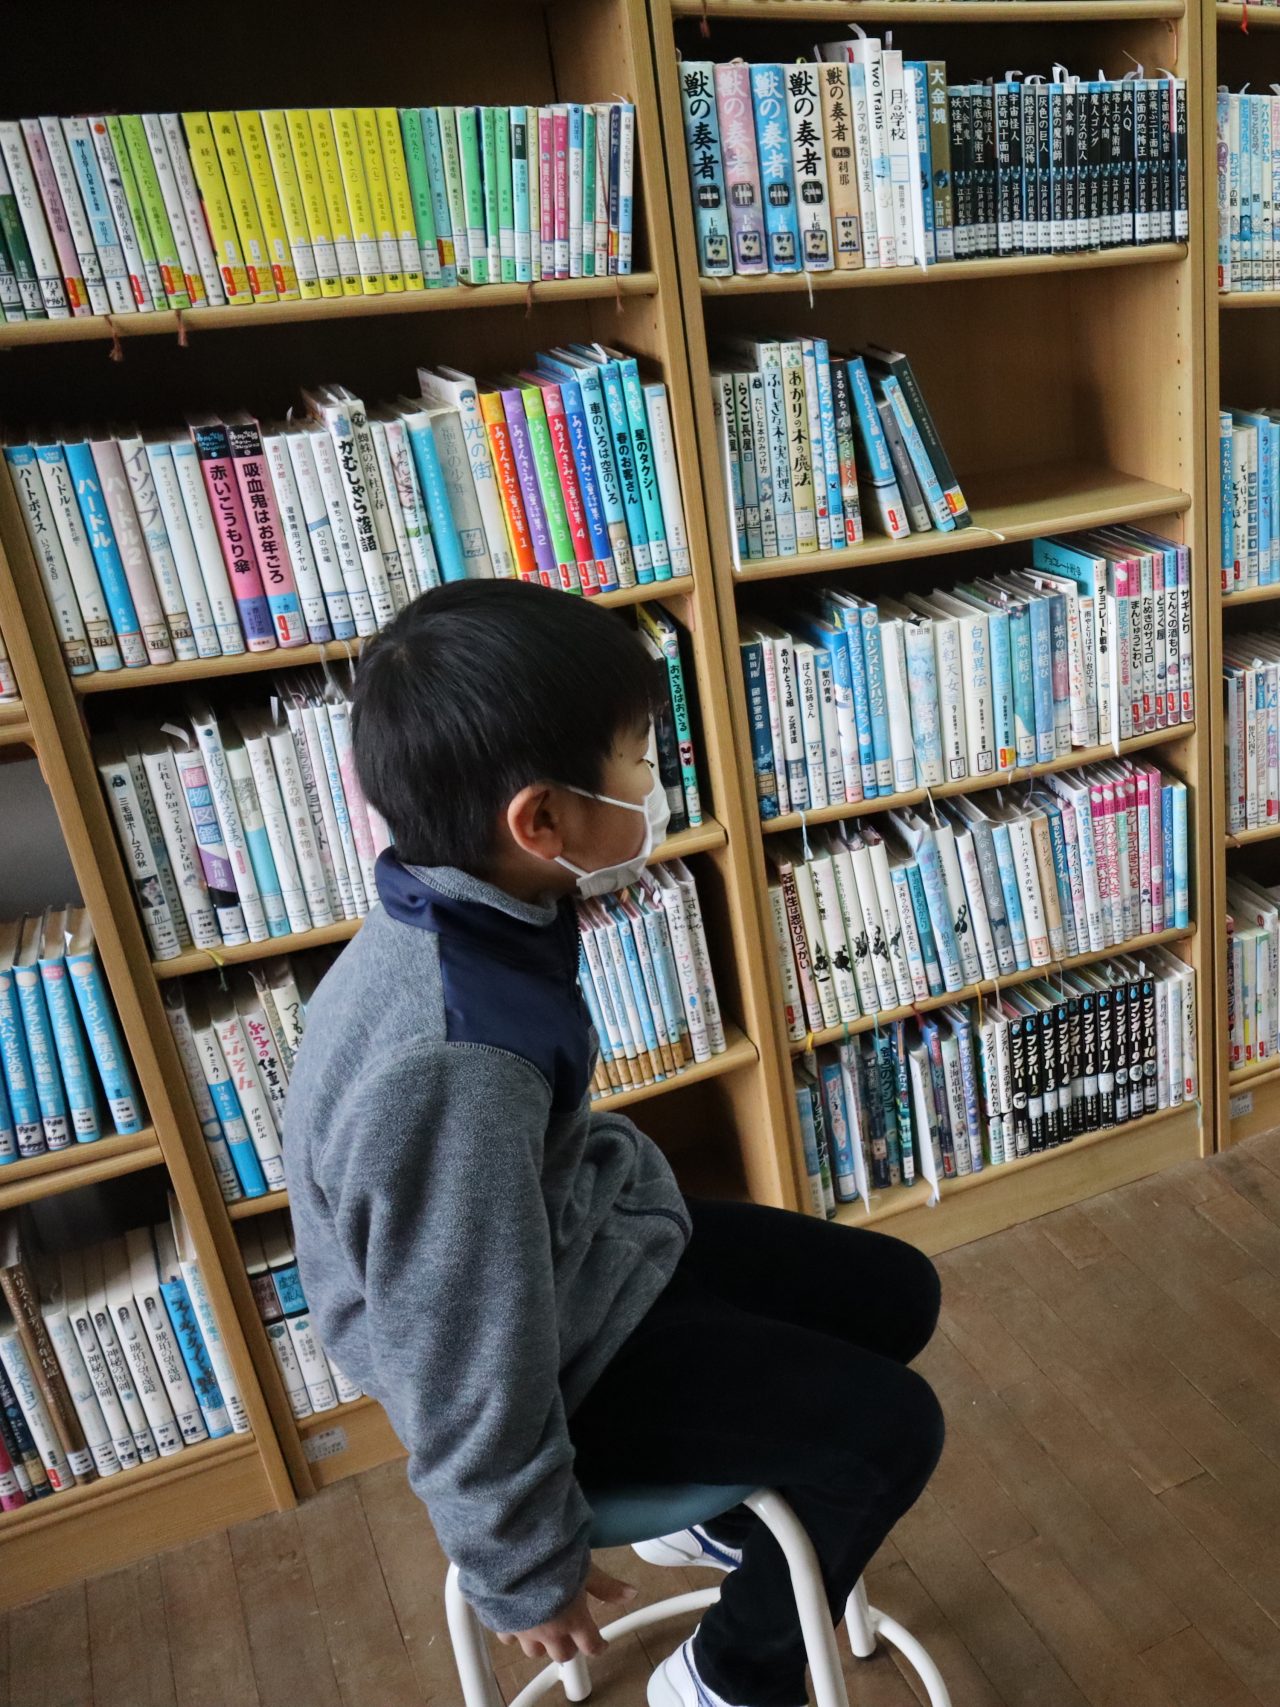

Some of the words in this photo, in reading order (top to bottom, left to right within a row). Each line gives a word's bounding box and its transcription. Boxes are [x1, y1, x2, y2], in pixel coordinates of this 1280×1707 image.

[826, 67, 849, 141] 獣の奏者
[871, 59, 882, 88] Two
[930, 69, 946, 124] 大金塊
[683, 71, 719, 180] 獣の奏者
[718, 71, 750, 178] 獣の奏者
[753, 71, 788, 178] 獣の奏者
[788, 71, 821, 176] 獣の奏者
[875, 91, 883, 129] Trains
[890, 89, 906, 141] 月の学校
[951, 98, 963, 145] 妖怪博士
[972, 96, 984, 163] 地底の魔術王
[998, 94, 1009, 163] 怪奇四十面相
[1009, 93, 1020, 142] 宇宙怪人
[1024, 95, 1035, 164] 鉄塔王国の恐怖
[1039, 96, 1048, 152] 灰色の巨人
[1052, 95, 1062, 161] 海底の魔術師
[1065, 95, 1074, 136] 黄金豹
[1078, 95, 1087, 161] サーカスの怪人
[1090, 93, 1099, 146] 魔人ゴング
[1101, 93, 1110, 139] 夜光人間
[1112, 93, 1121, 156] 塔上の奇術師
[1123, 92, 1132, 131] 鉄人Q
[1137, 92, 1147, 156] 仮面の恐怖王
[1149, 91, 1159, 157] 空飛ぶ二十面相
[1161, 90, 1170, 152] 奇面城の秘密
[1176, 90, 1186, 134] 魔法人形
[856, 100, 872, 192] クマのあたりまえ
[738, 382, 753, 452] らくご長屋
[767, 372, 791, 503] ふしぎな木の実の料理法
[789, 370, 812, 488] あかりの木の魔法
[464, 418, 492, 481] 光の街
[589, 402, 619, 506] 車のいろは空のいろ
[616, 432, 638, 506] 春のお客さん
[634, 429, 654, 501] 星のタクシー
[19, 469, 46, 534] ハートボイス
[51, 465, 70, 507] ハードル
[78, 478, 111, 549] ハードル
[127, 446, 162, 529] イソップ
[338, 441, 377, 553] がむしゃら落語
[209, 465, 251, 574] 赤いこうもり傘
[243, 462, 284, 584] 吸血鬼はお年ごろ
[520, 538, 527, 548] 1
[538, 534, 547, 545] 2
[559, 530, 566, 541] 3
[577, 528, 585, 539] 4
[594, 525, 603, 535] 5
[888, 509, 898, 531] 9
[560, 563, 571, 588] 9
[276, 615, 291, 641] 9
[1084, 610, 1093, 688] 雨やどりはすべり台の下で
[1098, 586, 1107, 655] チョコレート戦争
[1131, 600, 1142, 670] まんじゅうこわい
[1143, 597, 1154, 664] たぬきのサイコロ
[1167, 591, 1178, 657] てんぐの酒もり
[781, 648, 794, 707] ありがとう3組
[822, 671, 832, 703] 聖の青春
[971, 626, 987, 688] 白鳥異伝
[669, 664, 687, 733] おさるはおさる
[802, 662, 815, 718] ぼくのお姉さん
[1133, 703, 1140, 723] 9
[1168, 691, 1175, 711] 9
[1183, 689, 1190, 710] 9
[119, 797, 147, 868] 三毛猫ホームズの秋
[1012, 1038, 1023, 1089] ブンダバー
[1185, 1078, 1193, 1094] 9
